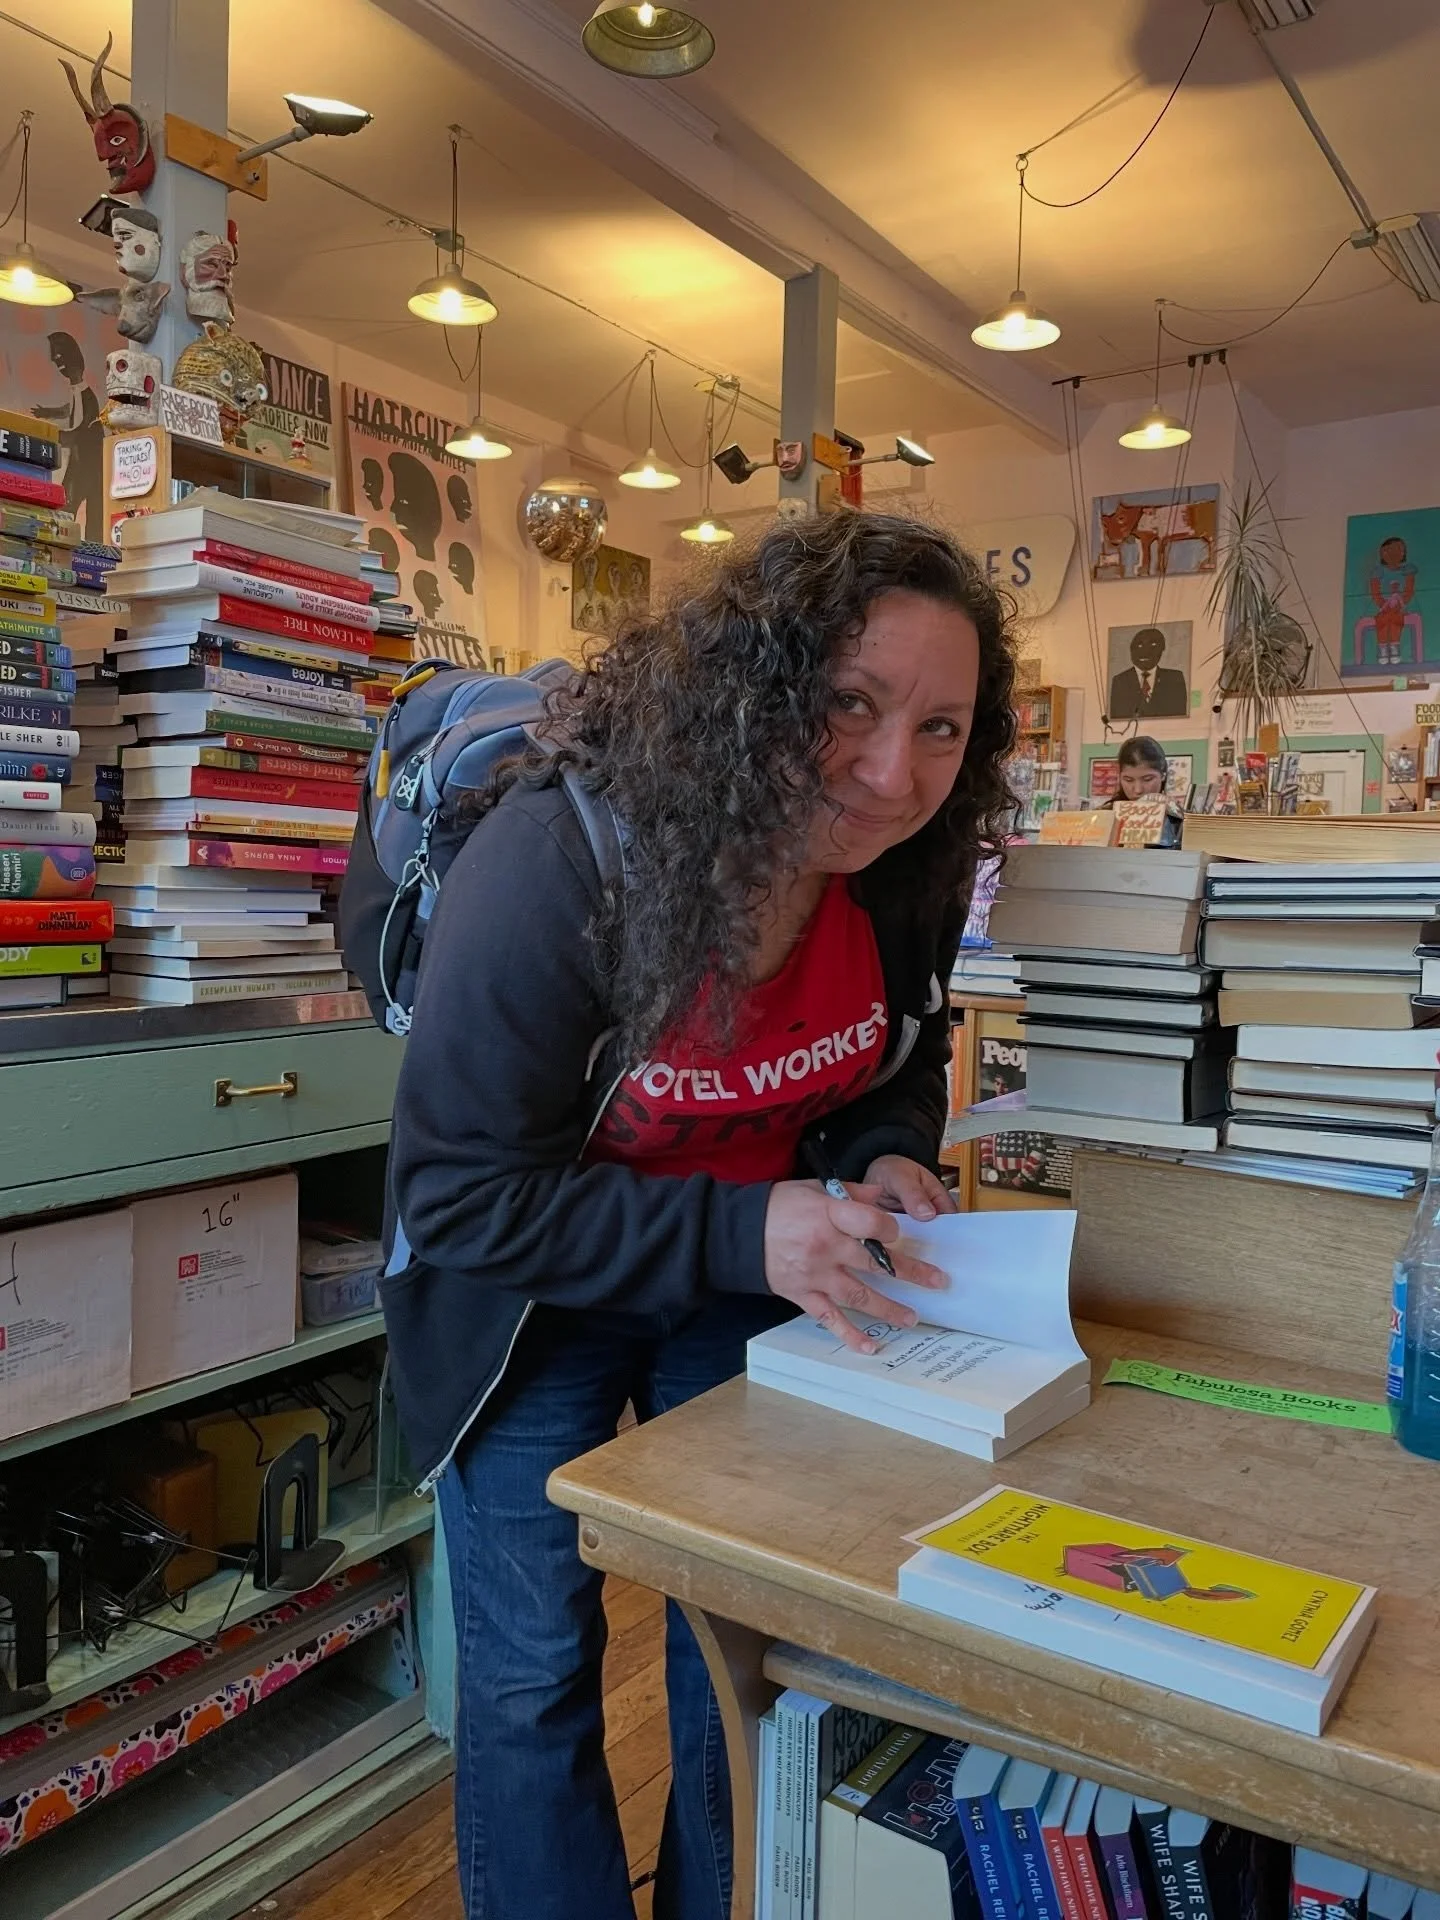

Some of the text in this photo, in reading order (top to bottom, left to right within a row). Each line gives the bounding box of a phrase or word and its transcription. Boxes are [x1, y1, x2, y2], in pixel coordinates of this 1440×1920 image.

[269, 357, 324, 419] DANCE
[305, 421, 329, 443] NOW
[353, 387, 463, 448] HAIRCUT
[117, 444, 142, 456] TAKING
[57, 592, 122, 613] ODYSSEY
[283, 615, 310, 633] TREE
[313, 622, 354, 643] LEMON
[291, 667, 325, 687] Korea
[16, 733, 43, 744] SHER
[266, 758, 349, 779] shred sisters
[250, 780, 283, 792] OCTAVIA
[244, 850, 302, 862] ANNA BURNS
[0, 852, 10, 893] Hassen
[10, 852, 22, 894] Khemiri
[50, 911, 77, 921] MATT
[246, 982, 276, 993] HUMANS
[1171, 1372, 1274, 1400] Fabulosa
[1280, 1393, 1358, 1413] Books
[964, 1503, 1051, 1556] NIGHTMARE BOX
[1016, 1531, 1041, 1545] THE
[1297, 1590, 1329, 1619] CYNTHIA
[857, 1731, 913, 1788] DAVID TALBOT
[1150, 1823, 1173, 1869] WIFE
[979, 1844, 1000, 1895] RACHEL
[1022, 1852, 1045, 1903] RACHEL
[1052, 1844, 1065, 1870] WHO
[1060, 1871, 1073, 1896] HAVE
[1076, 1852, 1089, 1879] WHO
[1084, 1879, 1097, 1903] HAVE
[1183, 1859, 1205, 1905] WIFE
